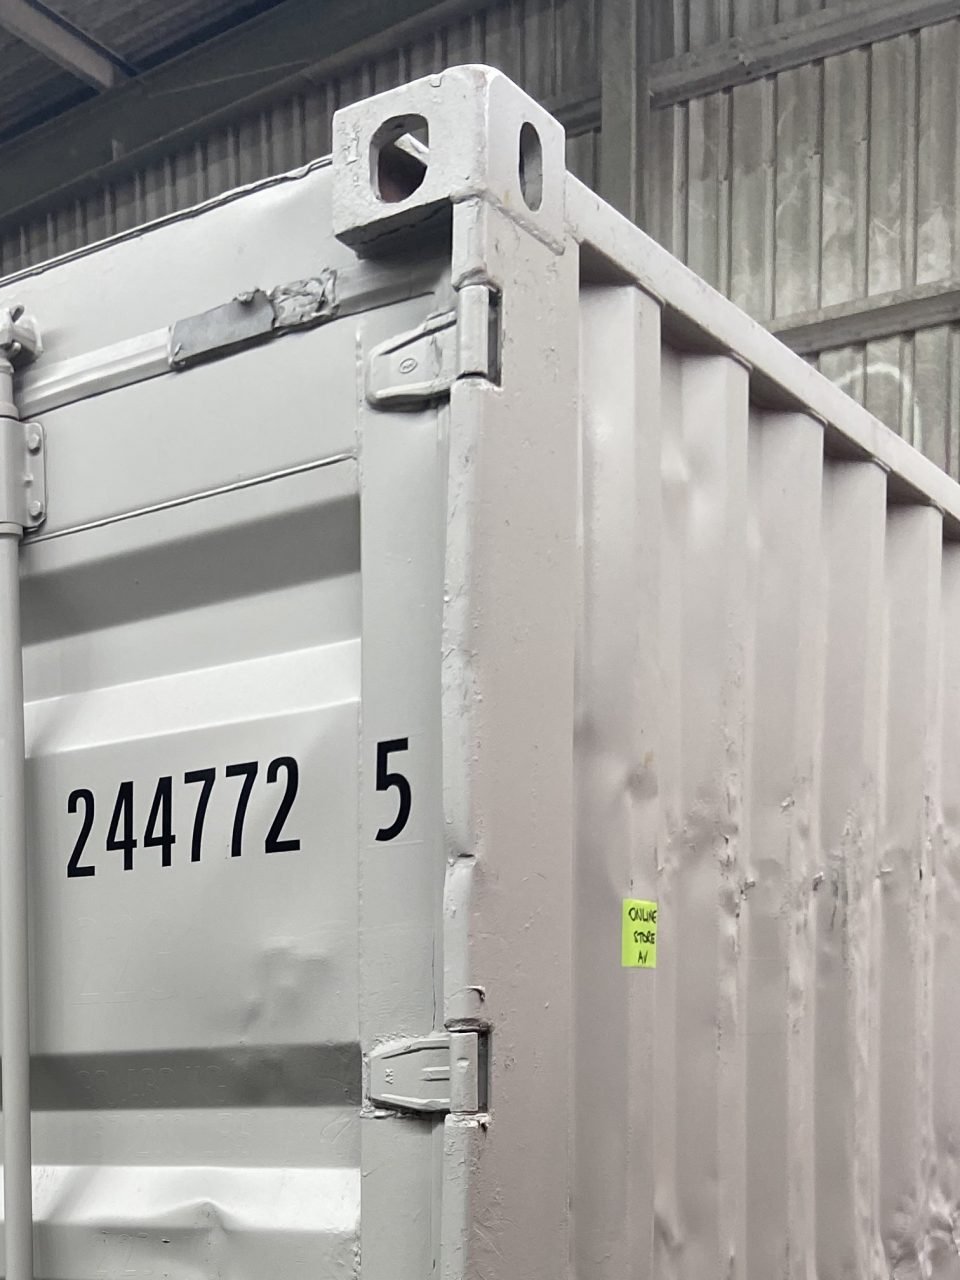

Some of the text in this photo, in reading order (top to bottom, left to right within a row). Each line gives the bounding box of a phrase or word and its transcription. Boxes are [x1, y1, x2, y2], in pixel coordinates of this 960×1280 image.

[67, 737, 412, 878] 244772 5
[628, 907, 657, 924] ONLINE
[634, 930, 656, 945] STORE
